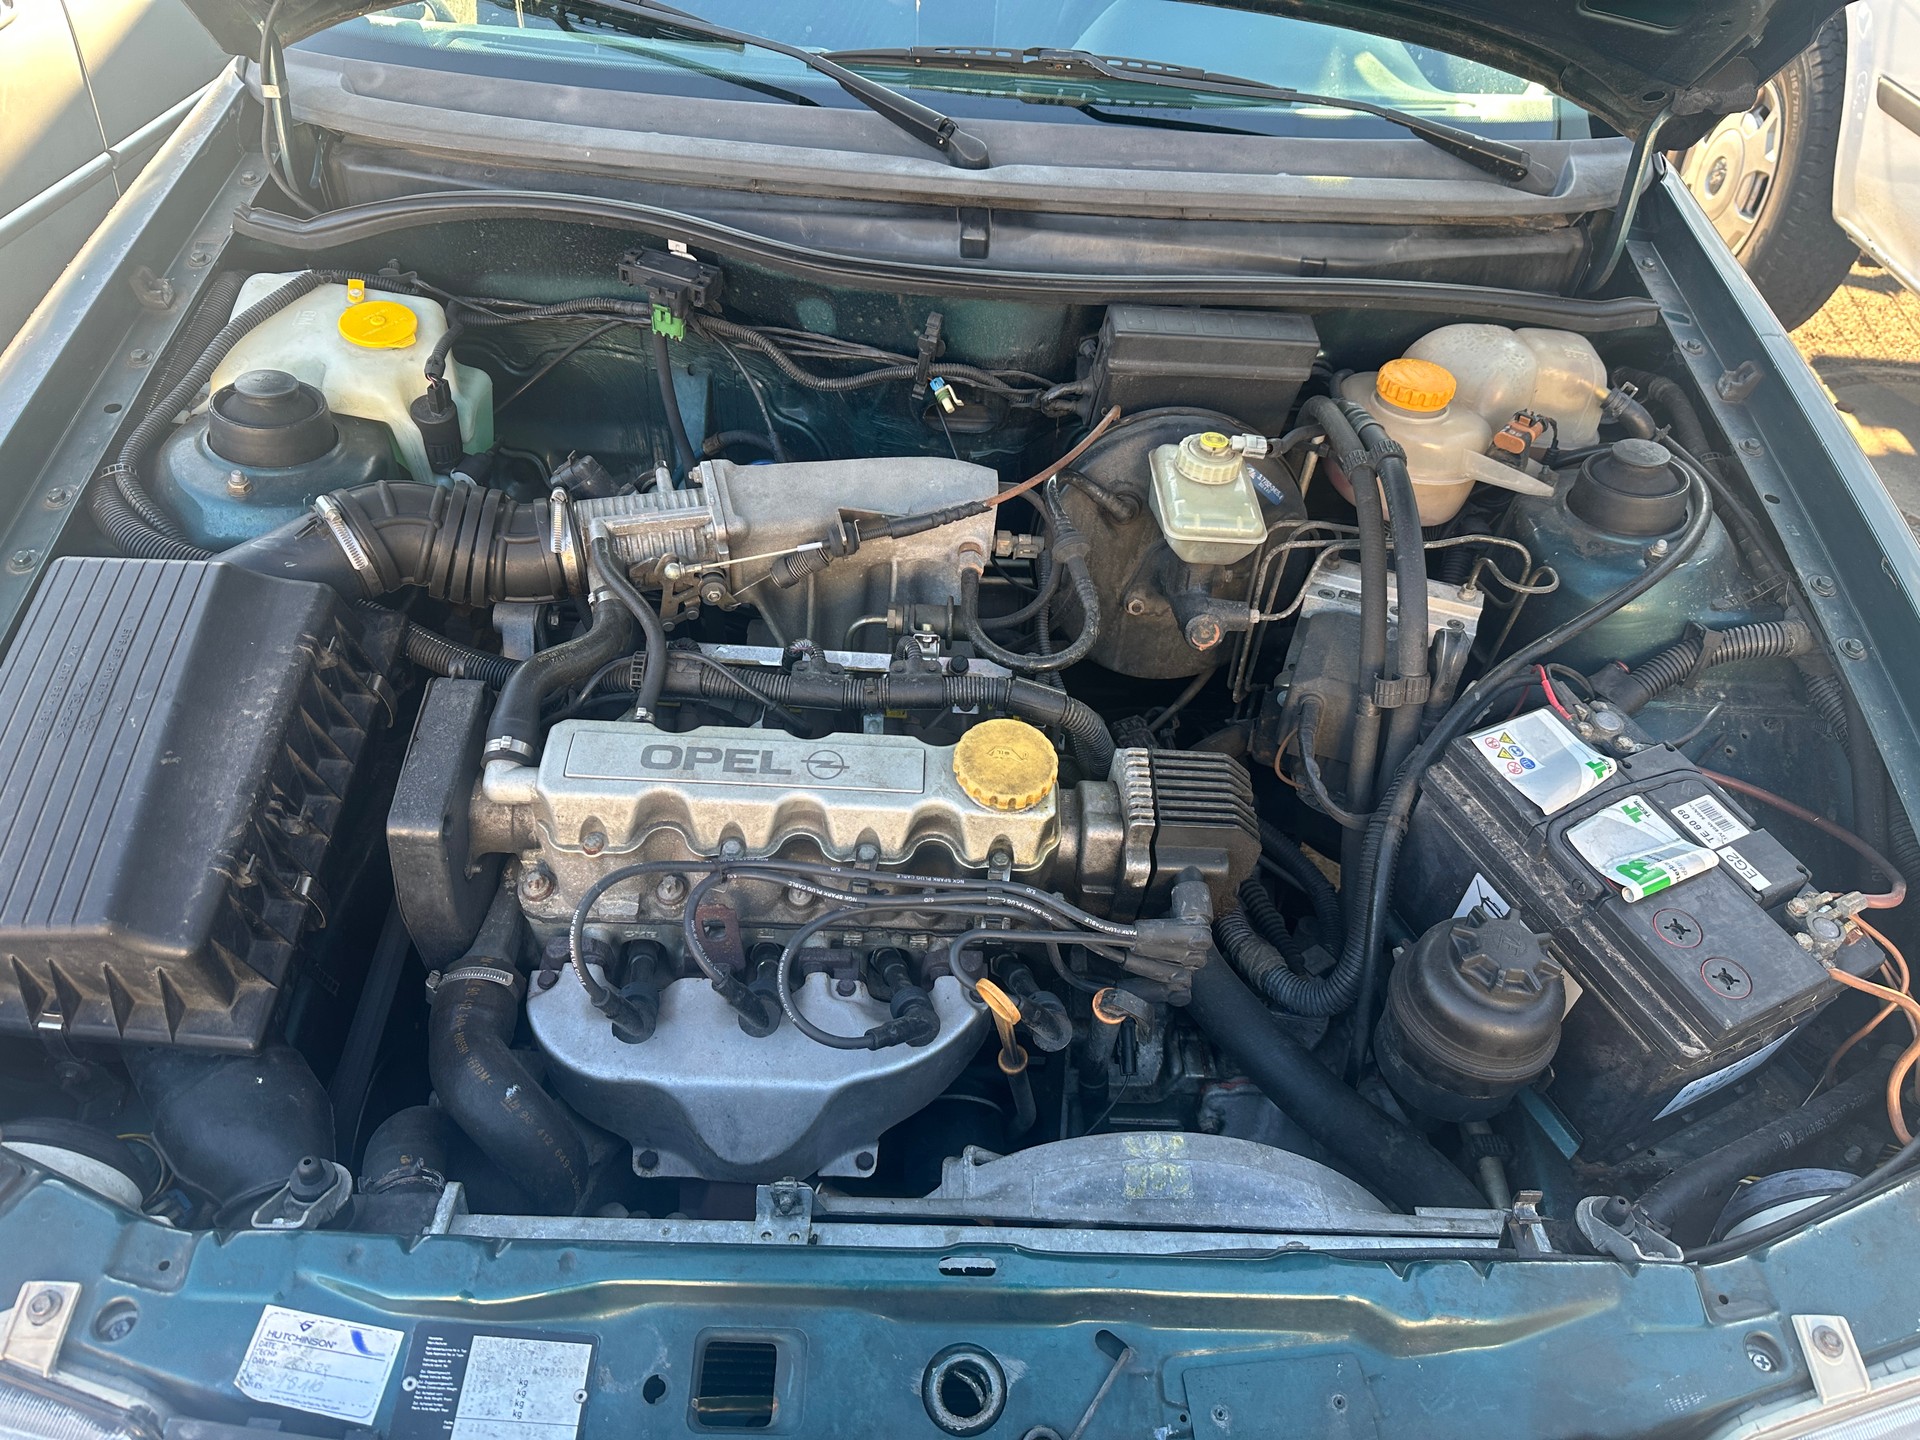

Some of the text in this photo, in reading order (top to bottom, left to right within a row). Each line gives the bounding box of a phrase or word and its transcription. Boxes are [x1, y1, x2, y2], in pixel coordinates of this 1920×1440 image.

[640, 744, 792, 775] OPEL
[1677, 809, 1715, 844] TE 60 09
[1726, 853, 1758, 880] EG2
[788, 881, 858, 903] NGK SPARK PLUG CABLE
[1005, 898, 1022, 907] PLUG
[1022, 903, 1041, 914] SPARK
[783, 1003, 797, 1022] CABLE
[267, 1330, 334, 1349] HUTCHINSON
[519, 1378, 529, 1388] kg
[516, 1389, 527, 1398] kg
[514, 1399, 525, 1409] kg
[512, 1409, 523, 1419] kg
